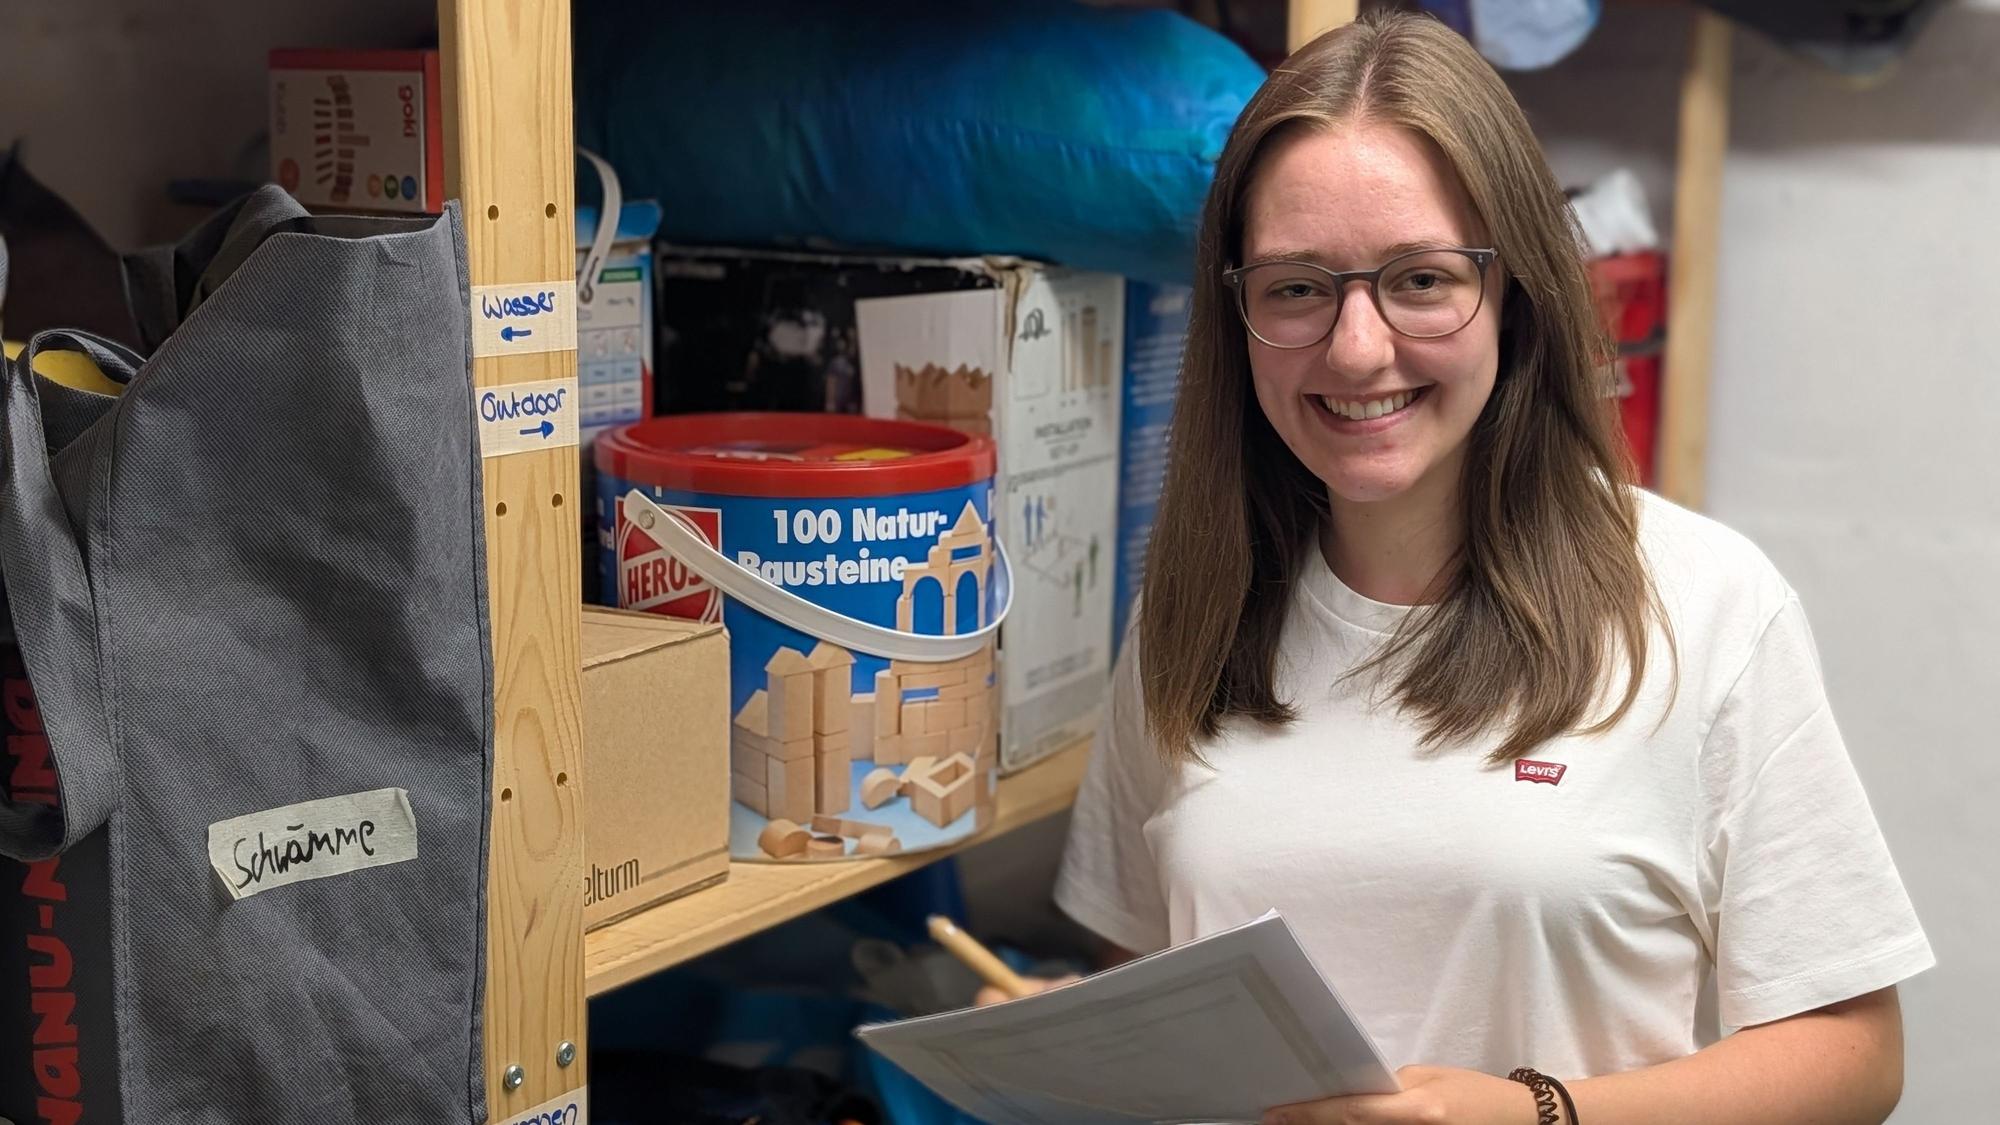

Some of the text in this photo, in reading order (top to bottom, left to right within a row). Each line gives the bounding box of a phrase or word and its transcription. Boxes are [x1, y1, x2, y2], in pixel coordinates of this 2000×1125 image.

[398, 85, 417, 138] goki
[482, 291, 555, 319] Wasser
[481, 388, 566, 422] Outdoor
[773, 507, 948, 544] 100 Natur-
[737, 547, 909, 586] Bausteine
